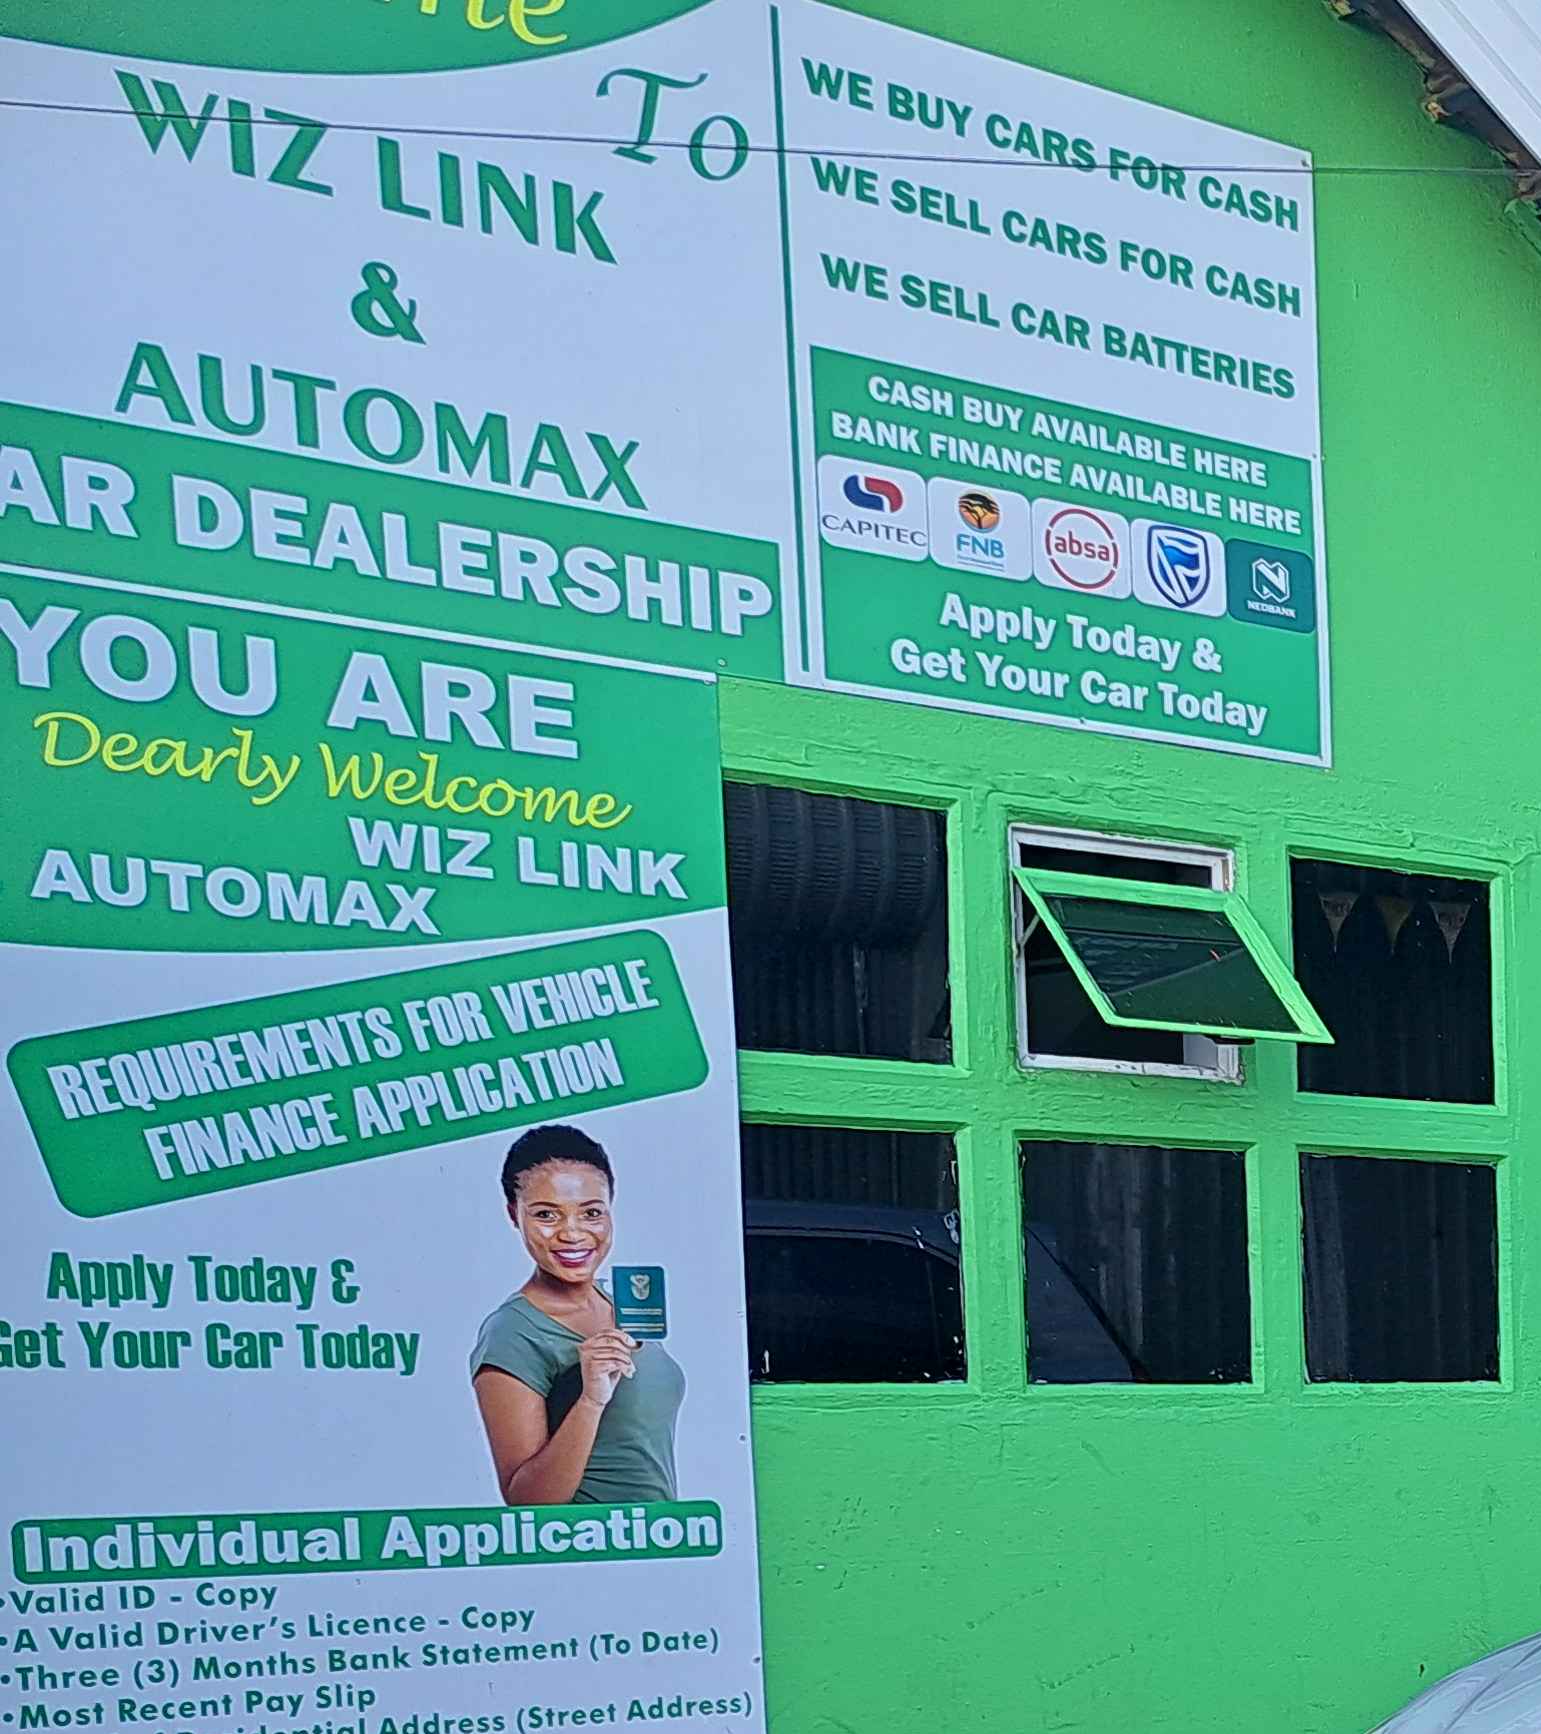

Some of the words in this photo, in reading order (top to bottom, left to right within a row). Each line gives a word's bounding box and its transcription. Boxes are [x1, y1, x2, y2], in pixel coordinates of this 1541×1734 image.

[115, 67, 334, 197] WIZ
[377, 135, 618, 265] LINK
[596, 67, 749, 181] To
[801, 57, 874, 111] WE
[887, 82, 974, 138] BUY
[985, 113, 1098, 173] CARS
[1109, 146, 1188, 200] FOR
[1199, 176, 1299, 232] CASH
[810, 155, 879, 206] WE
[889, 180, 992, 236] SELL
[1003, 210, 1108, 265] CARS
[1120, 240, 1193, 288] FOR
[1205, 265, 1301, 317] CASH
[350, 261, 427, 345] &
[820, 253, 889, 300] WE
[900, 274, 1000, 328] SELL
[1011, 302, 1090, 351] CAR
[1104, 324, 1296, 400] BATTERIES
[114, 341, 647, 511] AUTOMAX
[868, 375, 953, 418] CASH
[963, 395, 1023, 433] BUY
[1031, 412, 1186, 470] AVAILABLE
[1194, 447, 1267, 488] HERE
[831, 411, 922, 456] BANK
[928, 432, 1061, 485] FINANCE
[1069, 463, 1222, 520] AVAILABLE
[1228, 496, 1302, 535] HERE
[172, 473, 773, 638] DEALERSHIP
[822, 513, 928, 549] CAPITEC
[956, 533, 1005, 560] FNB
[1054, 531, 1112, 564] absa
[939, 591, 1056, 651] Apply
[1066, 614, 1182, 673] Today
[1192, 638, 1223, 673] &
[0, 598, 277, 717] YOU
[326, 651, 579, 759] ARE
[890, 639, 968, 683] Get
[975, 651, 1070, 699] Your
[1079, 670, 1149, 712] Car
[1157, 684, 1268, 736] Today
[32, 711, 300, 806] Dearly
[320, 742, 633, 829] Welcome
[30, 848, 441, 936] AUTOMAX
[347, 816, 495, 880] WIZ
[517, 836, 689, 899] LINK
[47, 1006, 402, 1121] REQUIREMENTS
[402, 982, 494, 1054] FOR
[489, 958, 660, 1033] VEHICLE
[143, 1092, 348, 1181] FINANCE
[355, 1037, 624, 1143] APPLICATION
[47, 1251, 173, 1309] Apply
[189, 1254, 318, 1310] Today
[330, 1257, 360, 1305] &
[77, 1321, 191, 1370] Your
[205, 1321, 283, 1370] Car
[296, 1323, 420, 1377] Today
[23, 1516, 362, 1574] Individual
[381, 1508, 718, 1567] Application
[10, 1586, 105, 1615] Valid
[119, 1585, 155, 1610] ID
[196, 1582, 278, 1611] Copy
[13, 1628, 38, 1653] A
[49, 1622, 143, 1650] Valid
[158, 1616, 296, 1646] Driver's
[308, 1612, 426, 1638] Licence
[461, 1606, 535, 1633] Copy
[20, 1702, 104, 1729] Most
[118, 1695, 232, 1722] Recent
[245, 1690, 303, 1717] Pay
[316, 1683, 376, 1712] Slip
[516, 1702, 616, 1734] (Street
[627, 1692, 753, 1722] Address)
